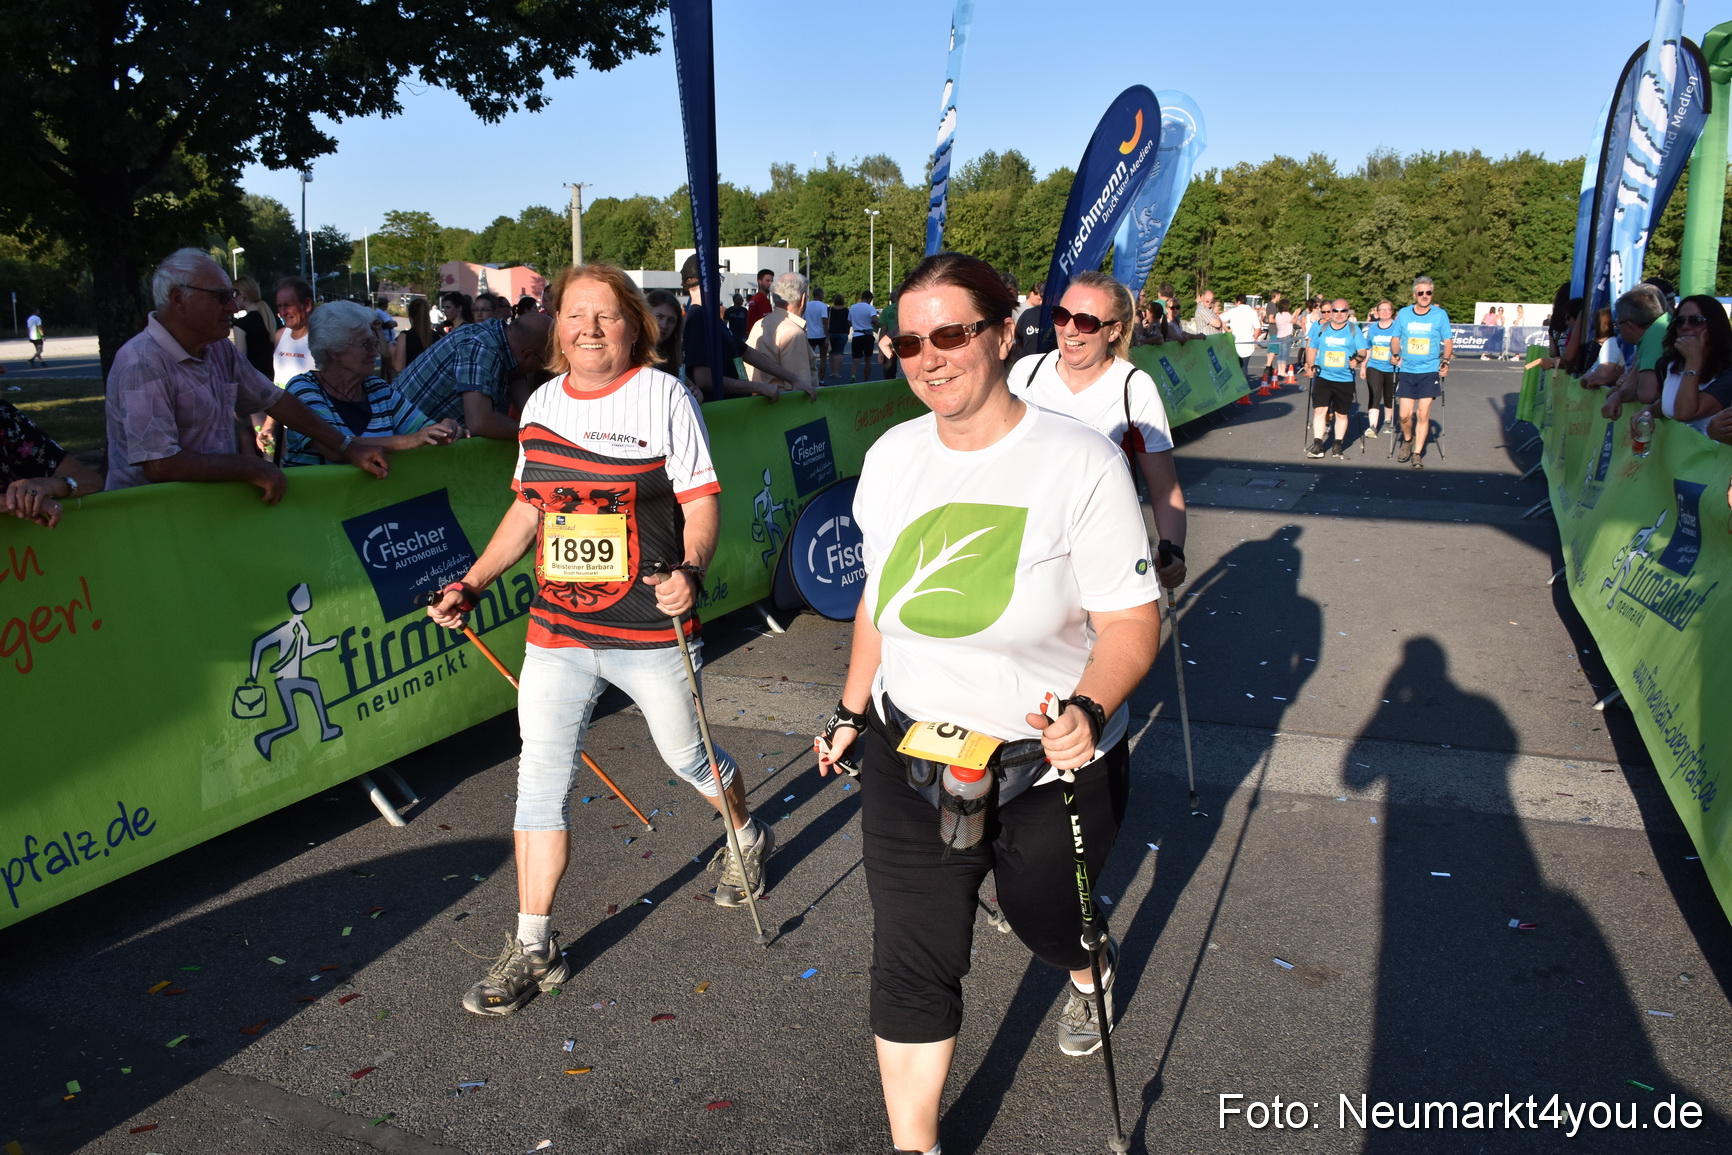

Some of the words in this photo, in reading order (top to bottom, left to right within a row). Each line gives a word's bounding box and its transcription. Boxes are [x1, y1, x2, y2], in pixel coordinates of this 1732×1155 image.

[1671, 75, 1698, 128] Medien
[1101, 194, 1120, 224] Druck
[1116, 175, 1131, 197] und
[1129, 139, 1154, 177] Medien
[1058, 160, 1128, 276] Frischmann
[1452, 335, 1488, 345] ischer
[583, 431, 638, 444] NEUMARKT
[798, 441, 826, 461] Fischer
[379, 526, 446, 562] Fischer
[394, 543, 449, 570] AUTOMOBILE
[551, 537, 614, 563] 1899
[551, 562, 585, 571] Bleisteiner
[585, 563, 614, 571] Barbara
[1634, 552, 1720, 633] firmenlauf
[1615, 599, 1647, 629] neumarkt
[357, 650, 468, 721] neumarkt
[1070, 814, 1084, 854] LEKI
